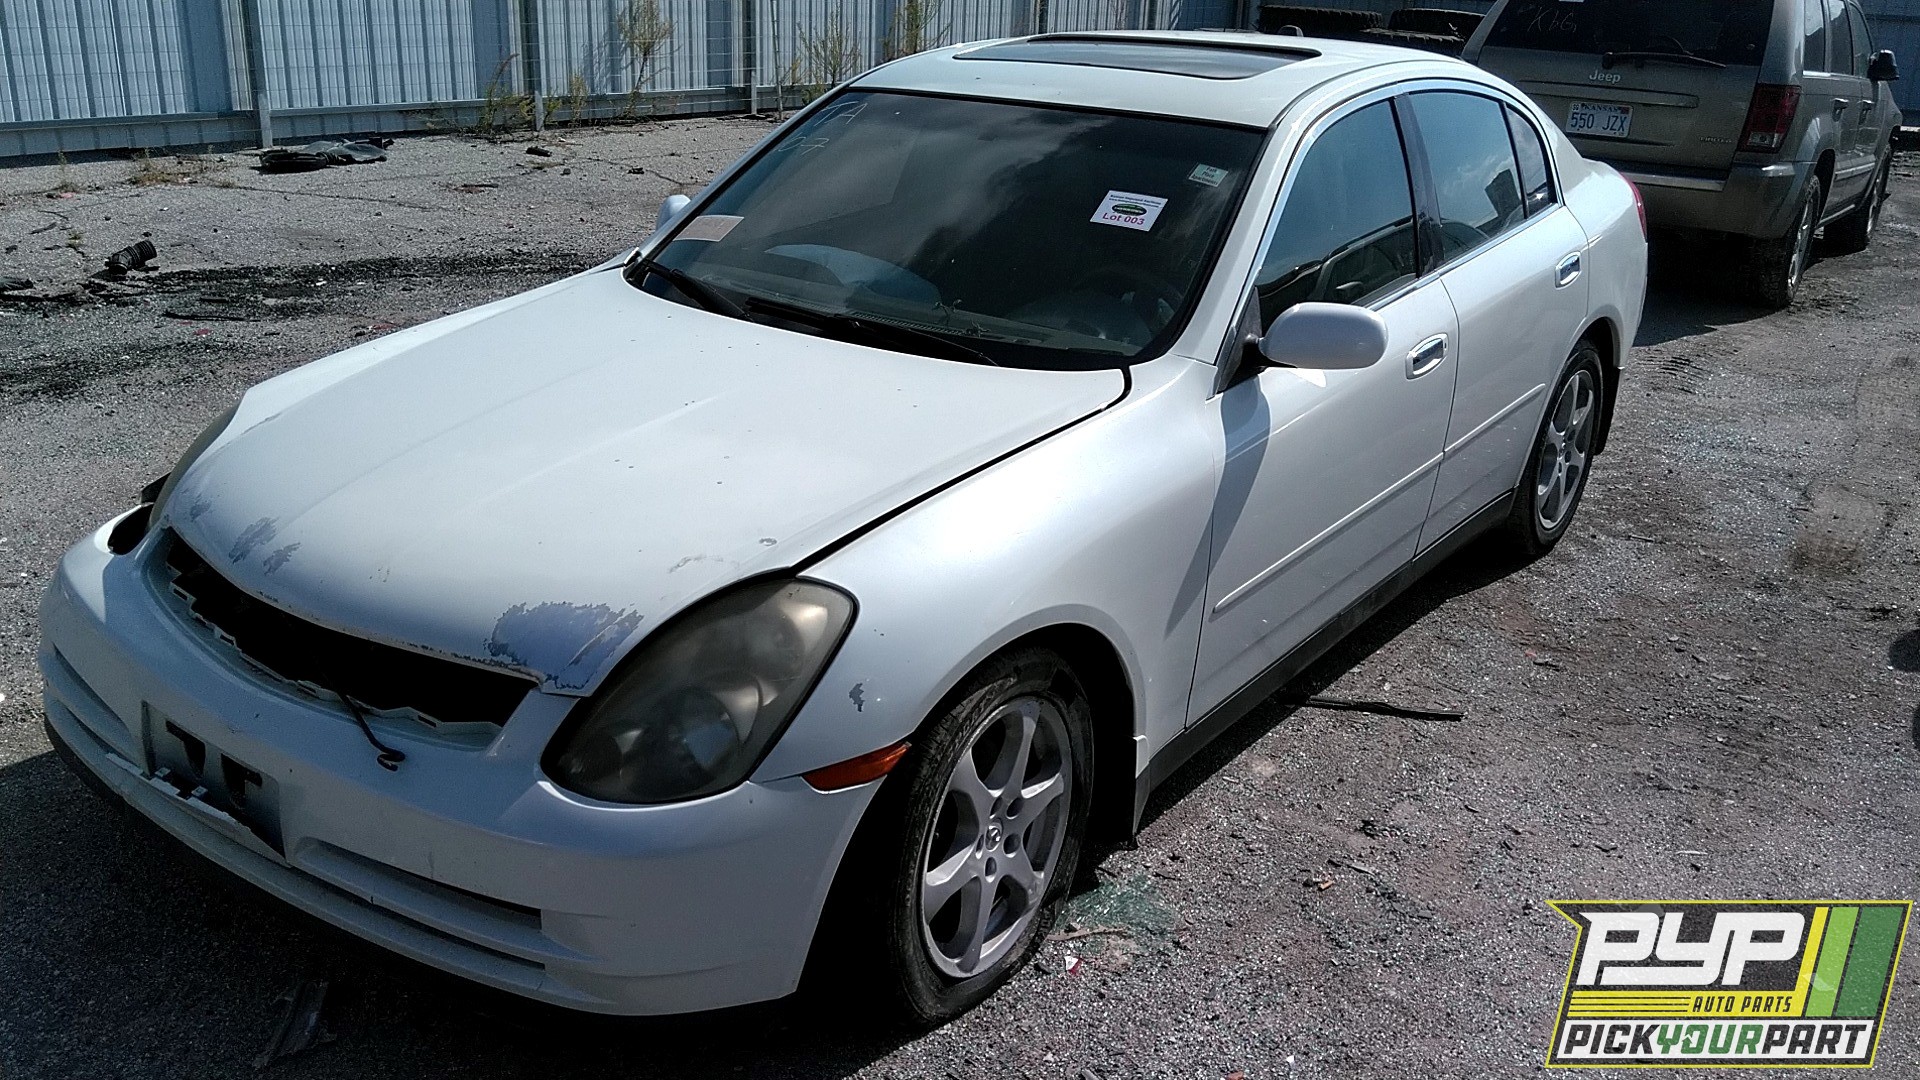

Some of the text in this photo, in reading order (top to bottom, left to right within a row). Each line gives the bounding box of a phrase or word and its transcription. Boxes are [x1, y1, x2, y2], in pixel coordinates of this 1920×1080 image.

[1589, 69, 1621, 84] Jeep
[1583, 103, 1620, 112] KANSAS
[1571, 112, 1627, 132] 550 JZX
[1102, 212, 1145, 226] Lot 003
